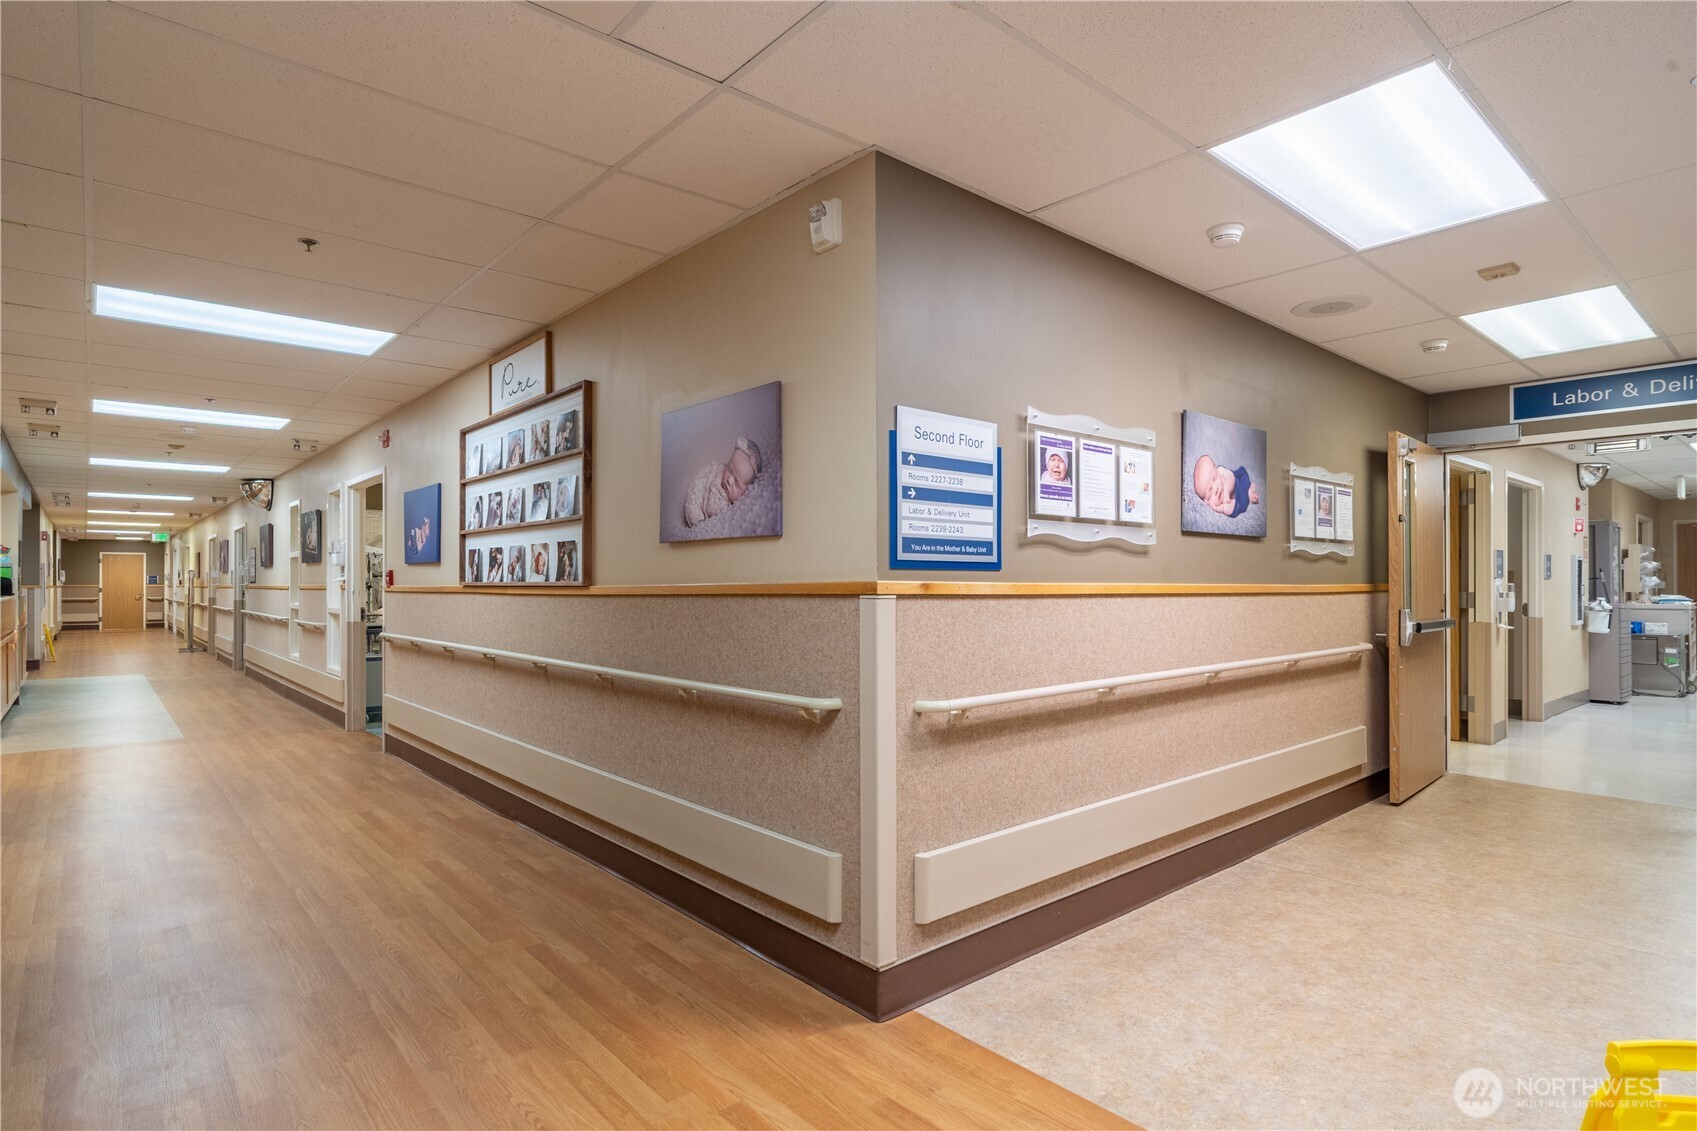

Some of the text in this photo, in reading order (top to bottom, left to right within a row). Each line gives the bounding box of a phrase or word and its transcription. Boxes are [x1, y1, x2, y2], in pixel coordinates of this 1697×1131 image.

[1552, 374, 1697, 406] Labor & Deli
[914, 425, 984, 449] Second Floor
[908, 472, 964, 486] Rooms 2227-2238
[908, 506, 970, 518] Labor & Delivery Unit
[908, 523, 964, 534] Rooms 2239-2243
[911, 543, 921, 551] You
[936, 544, 944, 552] the
[966, 545, 977, 553] Baby
